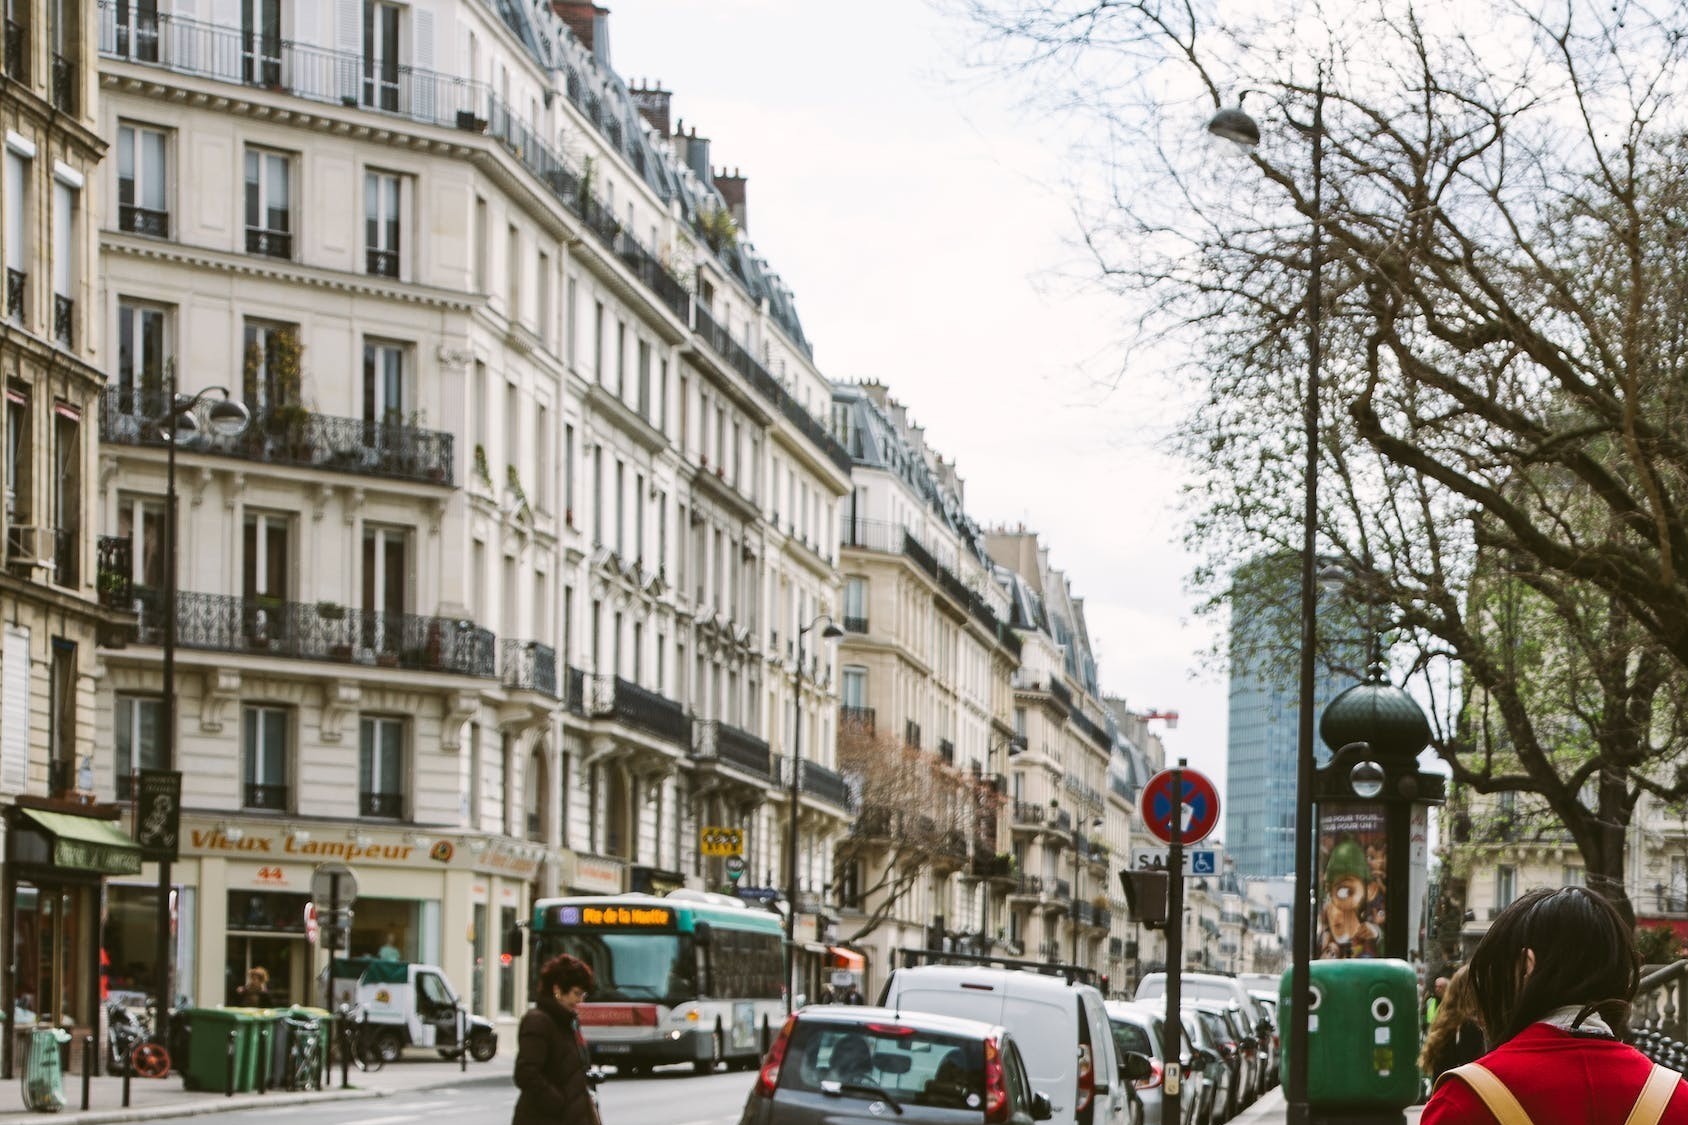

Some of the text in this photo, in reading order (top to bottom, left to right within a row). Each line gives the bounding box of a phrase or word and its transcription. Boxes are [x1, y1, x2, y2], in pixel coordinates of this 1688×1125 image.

[191, 828, 271, 852] Vieux
[1138, 854, 1188, 870] SAF
[257, 866, 282, 879] 44
[603, 907, 618, 924] de
